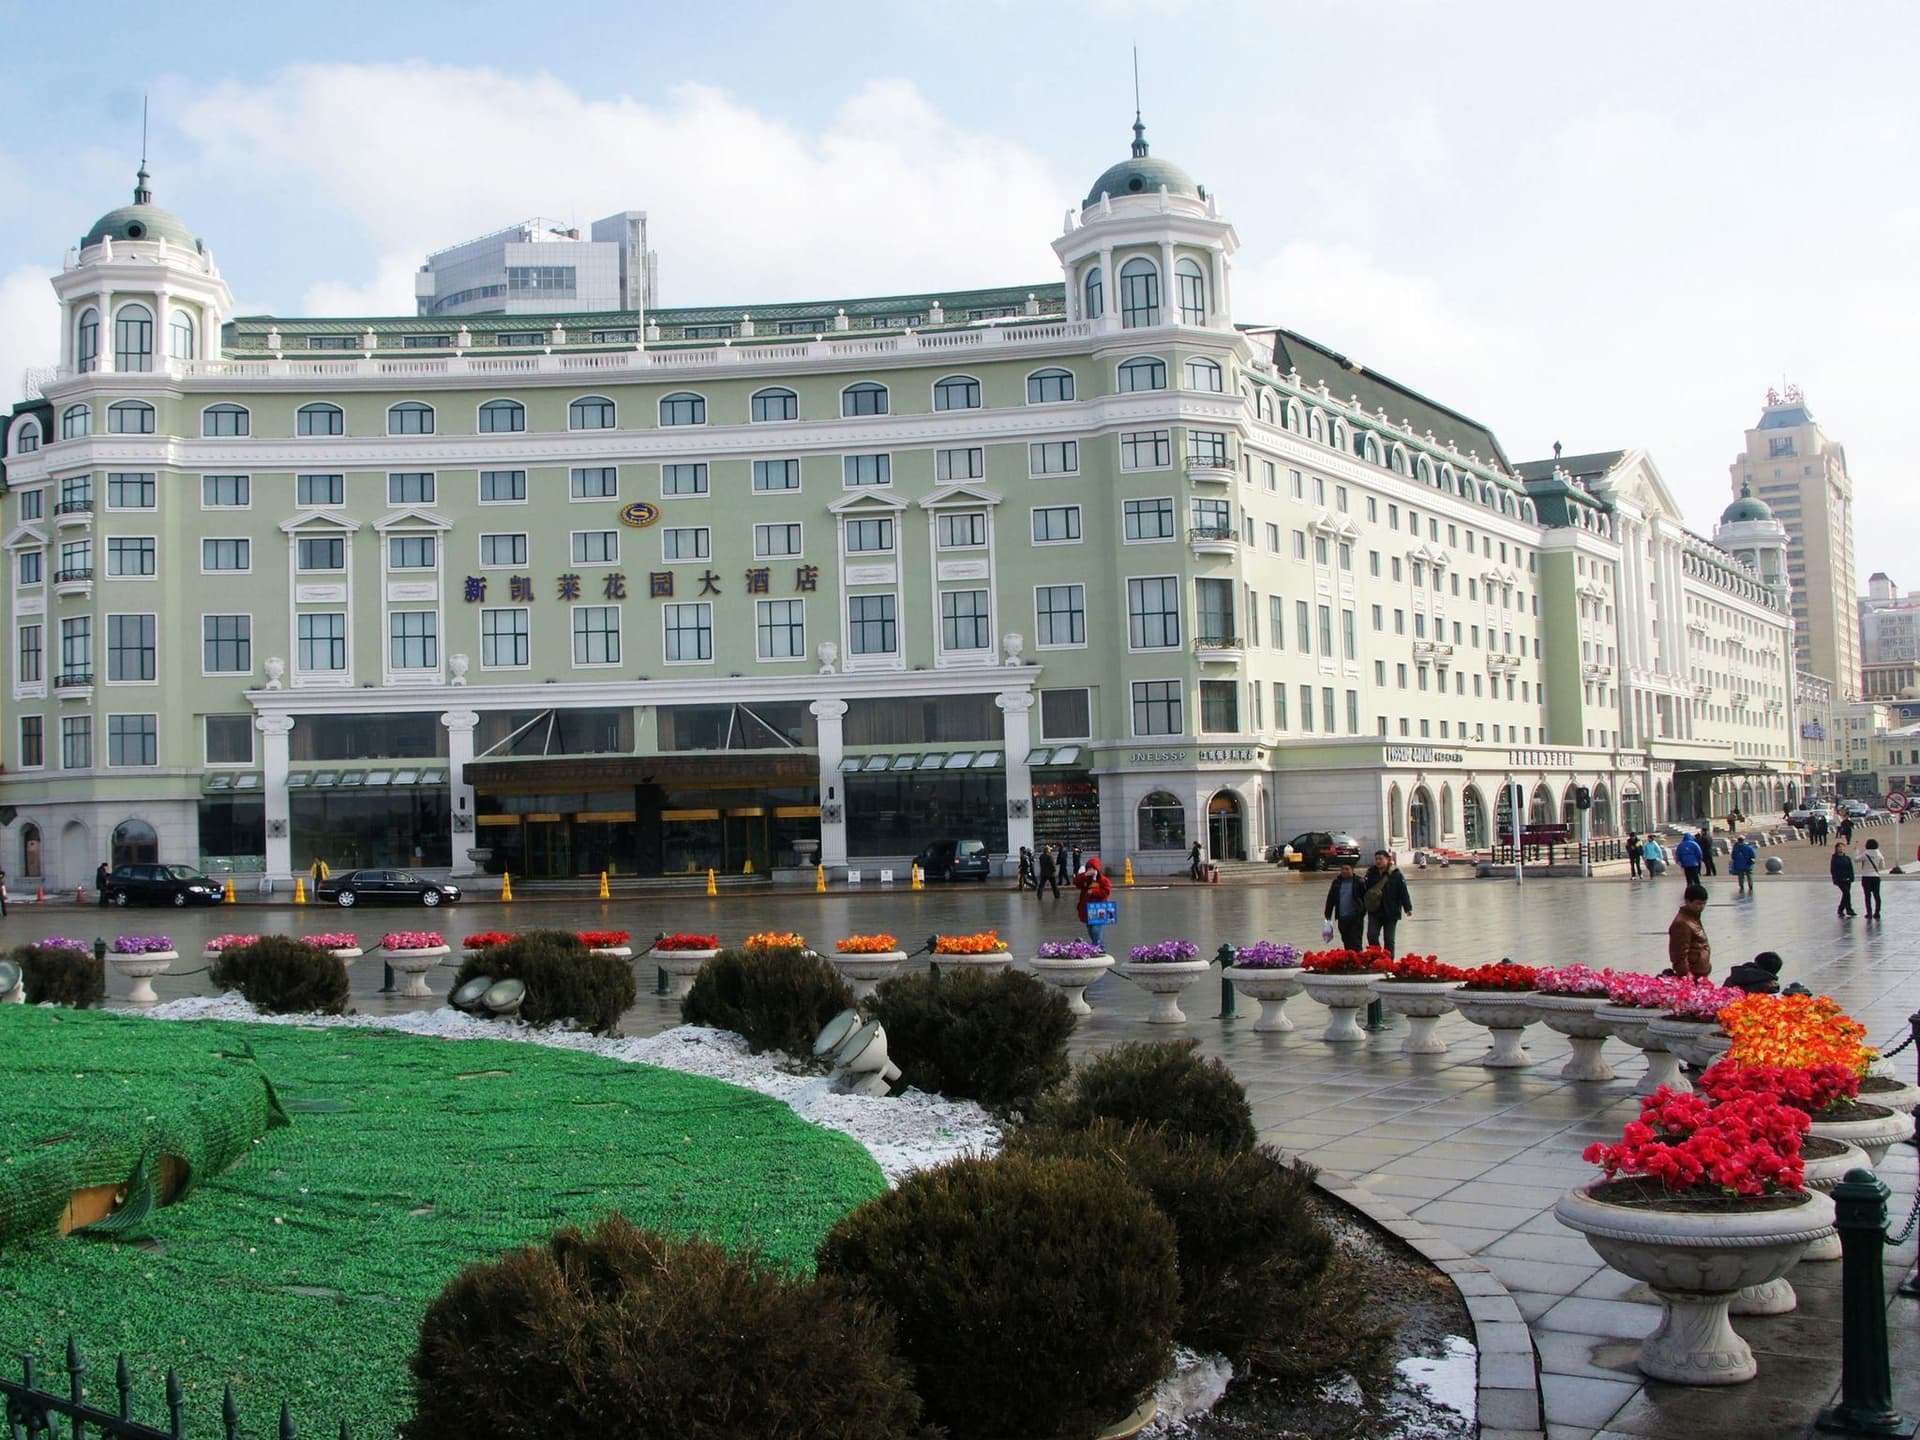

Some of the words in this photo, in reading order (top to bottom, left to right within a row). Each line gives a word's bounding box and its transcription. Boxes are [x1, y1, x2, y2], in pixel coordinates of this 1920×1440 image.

[464, 564, 820, 603] 新凯莱花园大酒店
